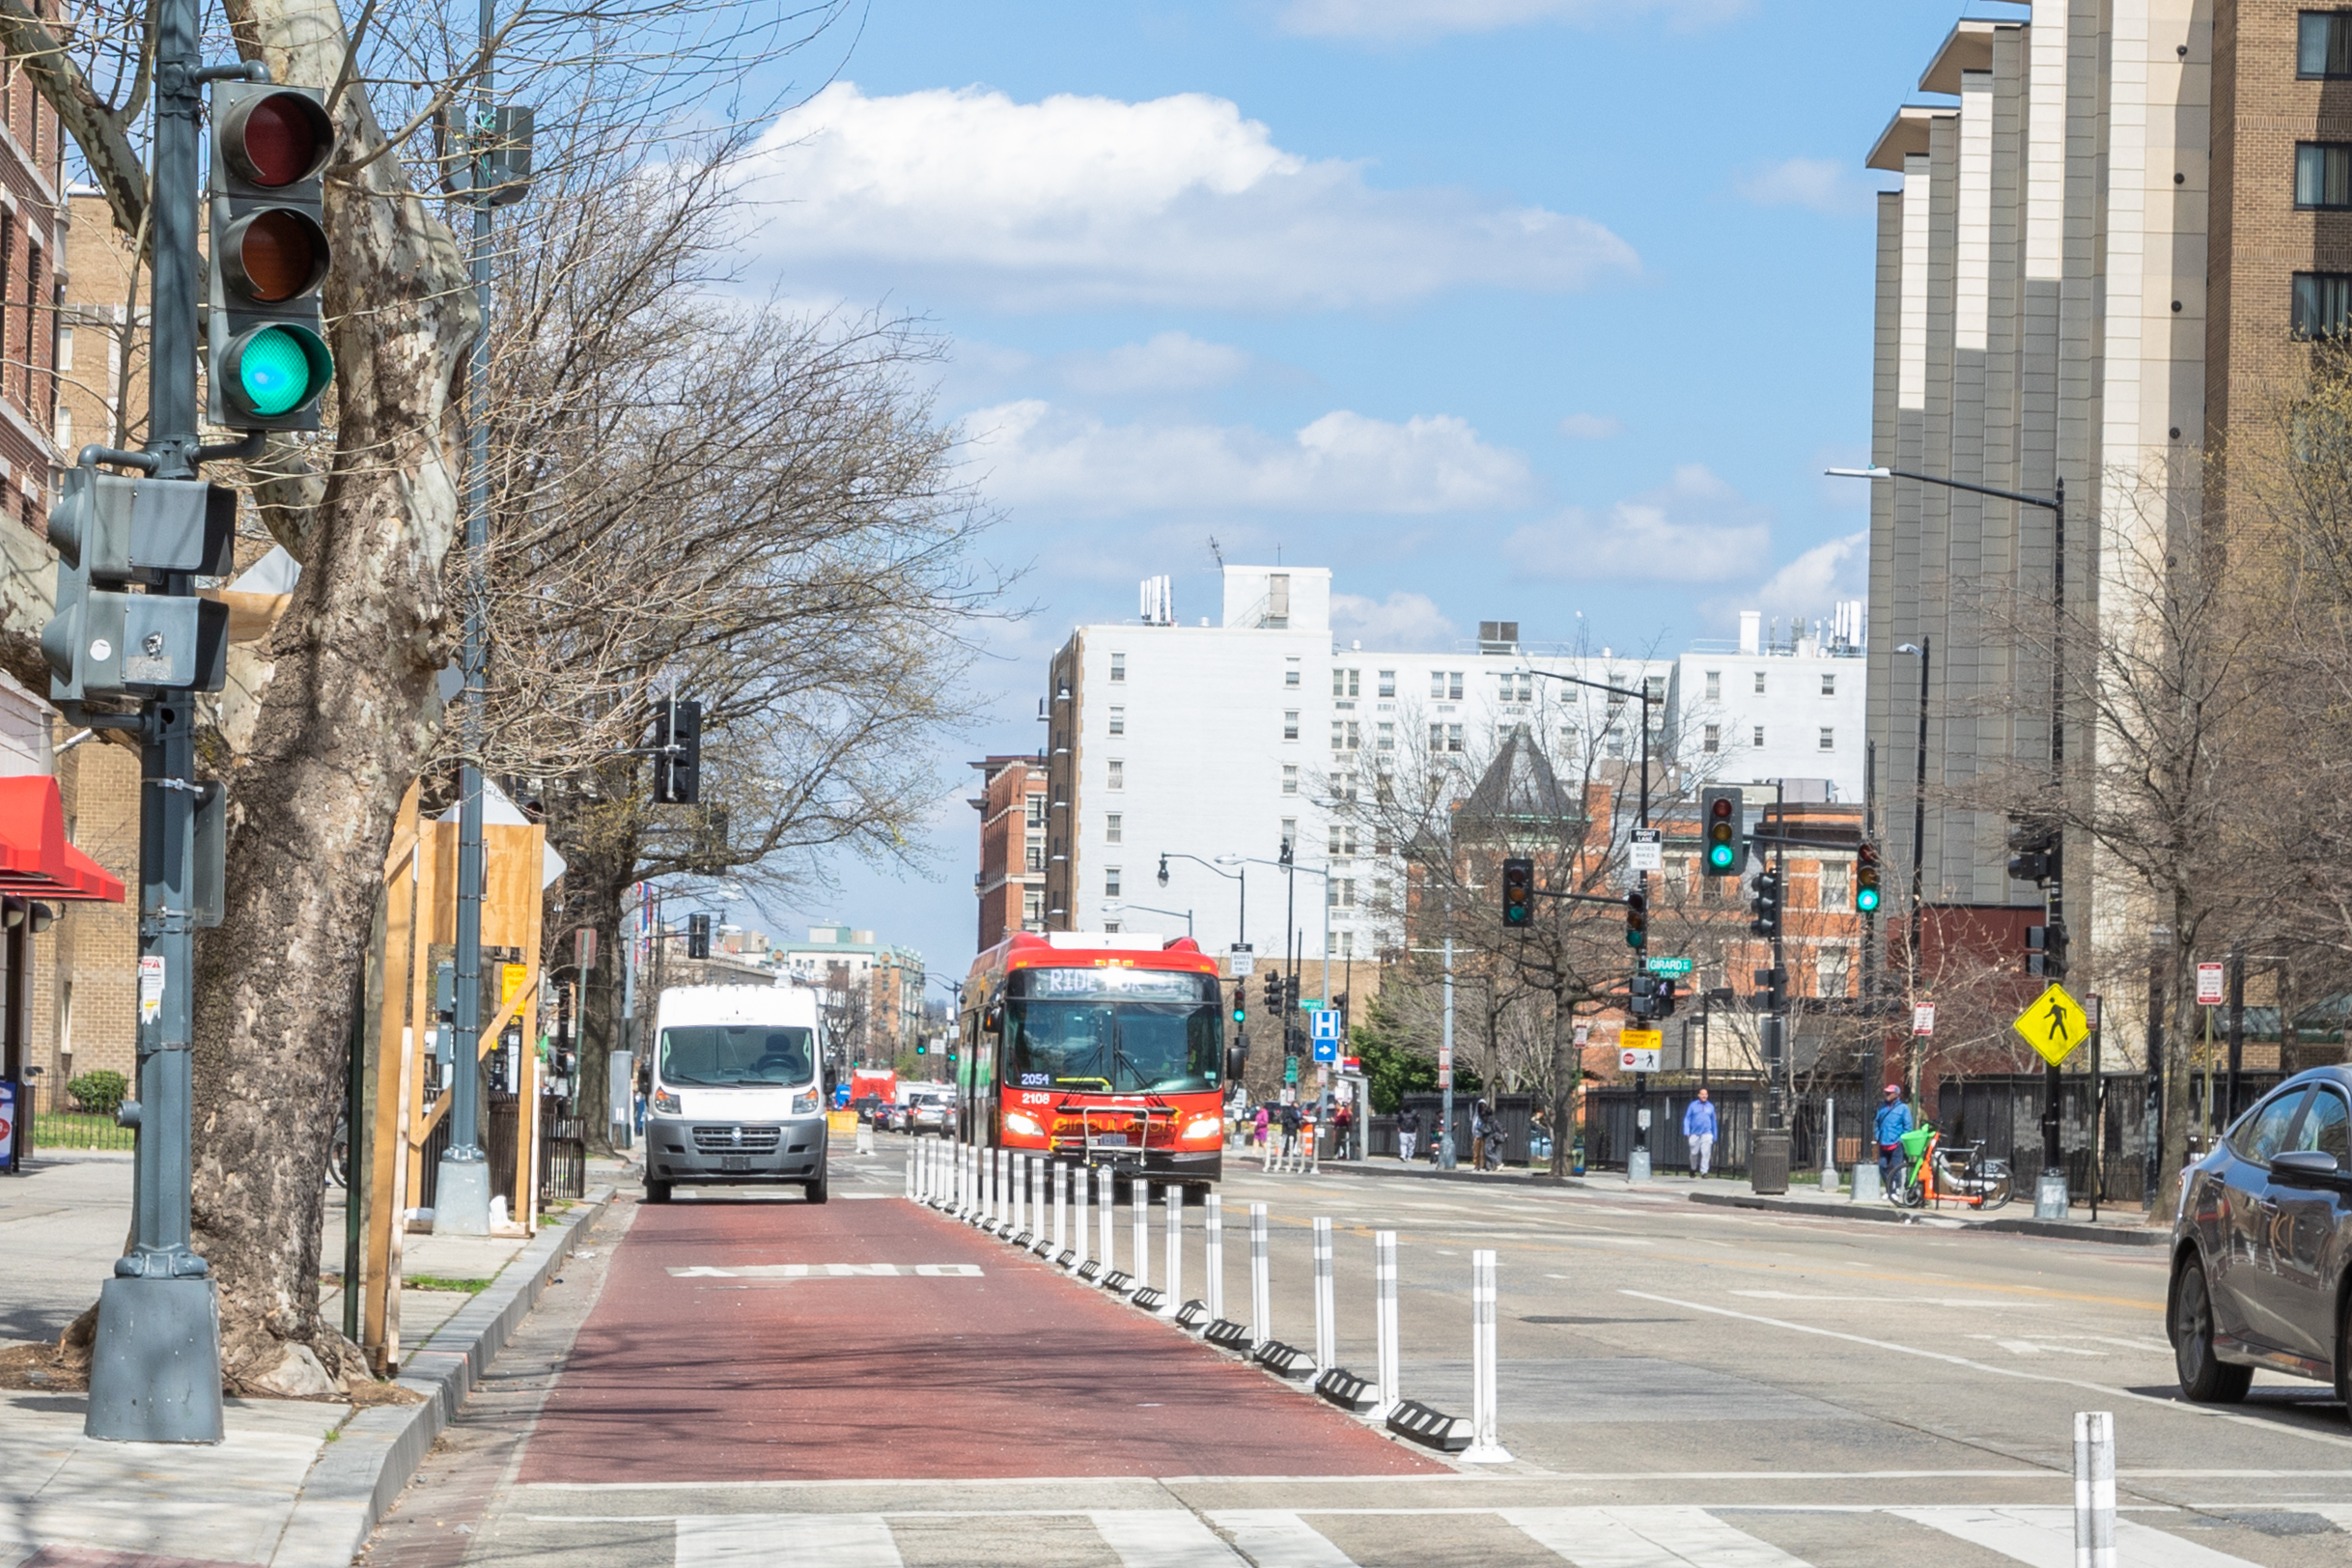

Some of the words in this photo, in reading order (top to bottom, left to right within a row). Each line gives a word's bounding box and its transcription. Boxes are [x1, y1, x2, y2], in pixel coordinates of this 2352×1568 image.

[1650, 960, 1682, 970] GIRARD
[1050, 968, 1097, 992] RIDE
[1315, 1012, 1335, 1037] H
[1021, 1073, 1050, 1085] 2054
[1022, 1092, 1050, 1105] 2108
